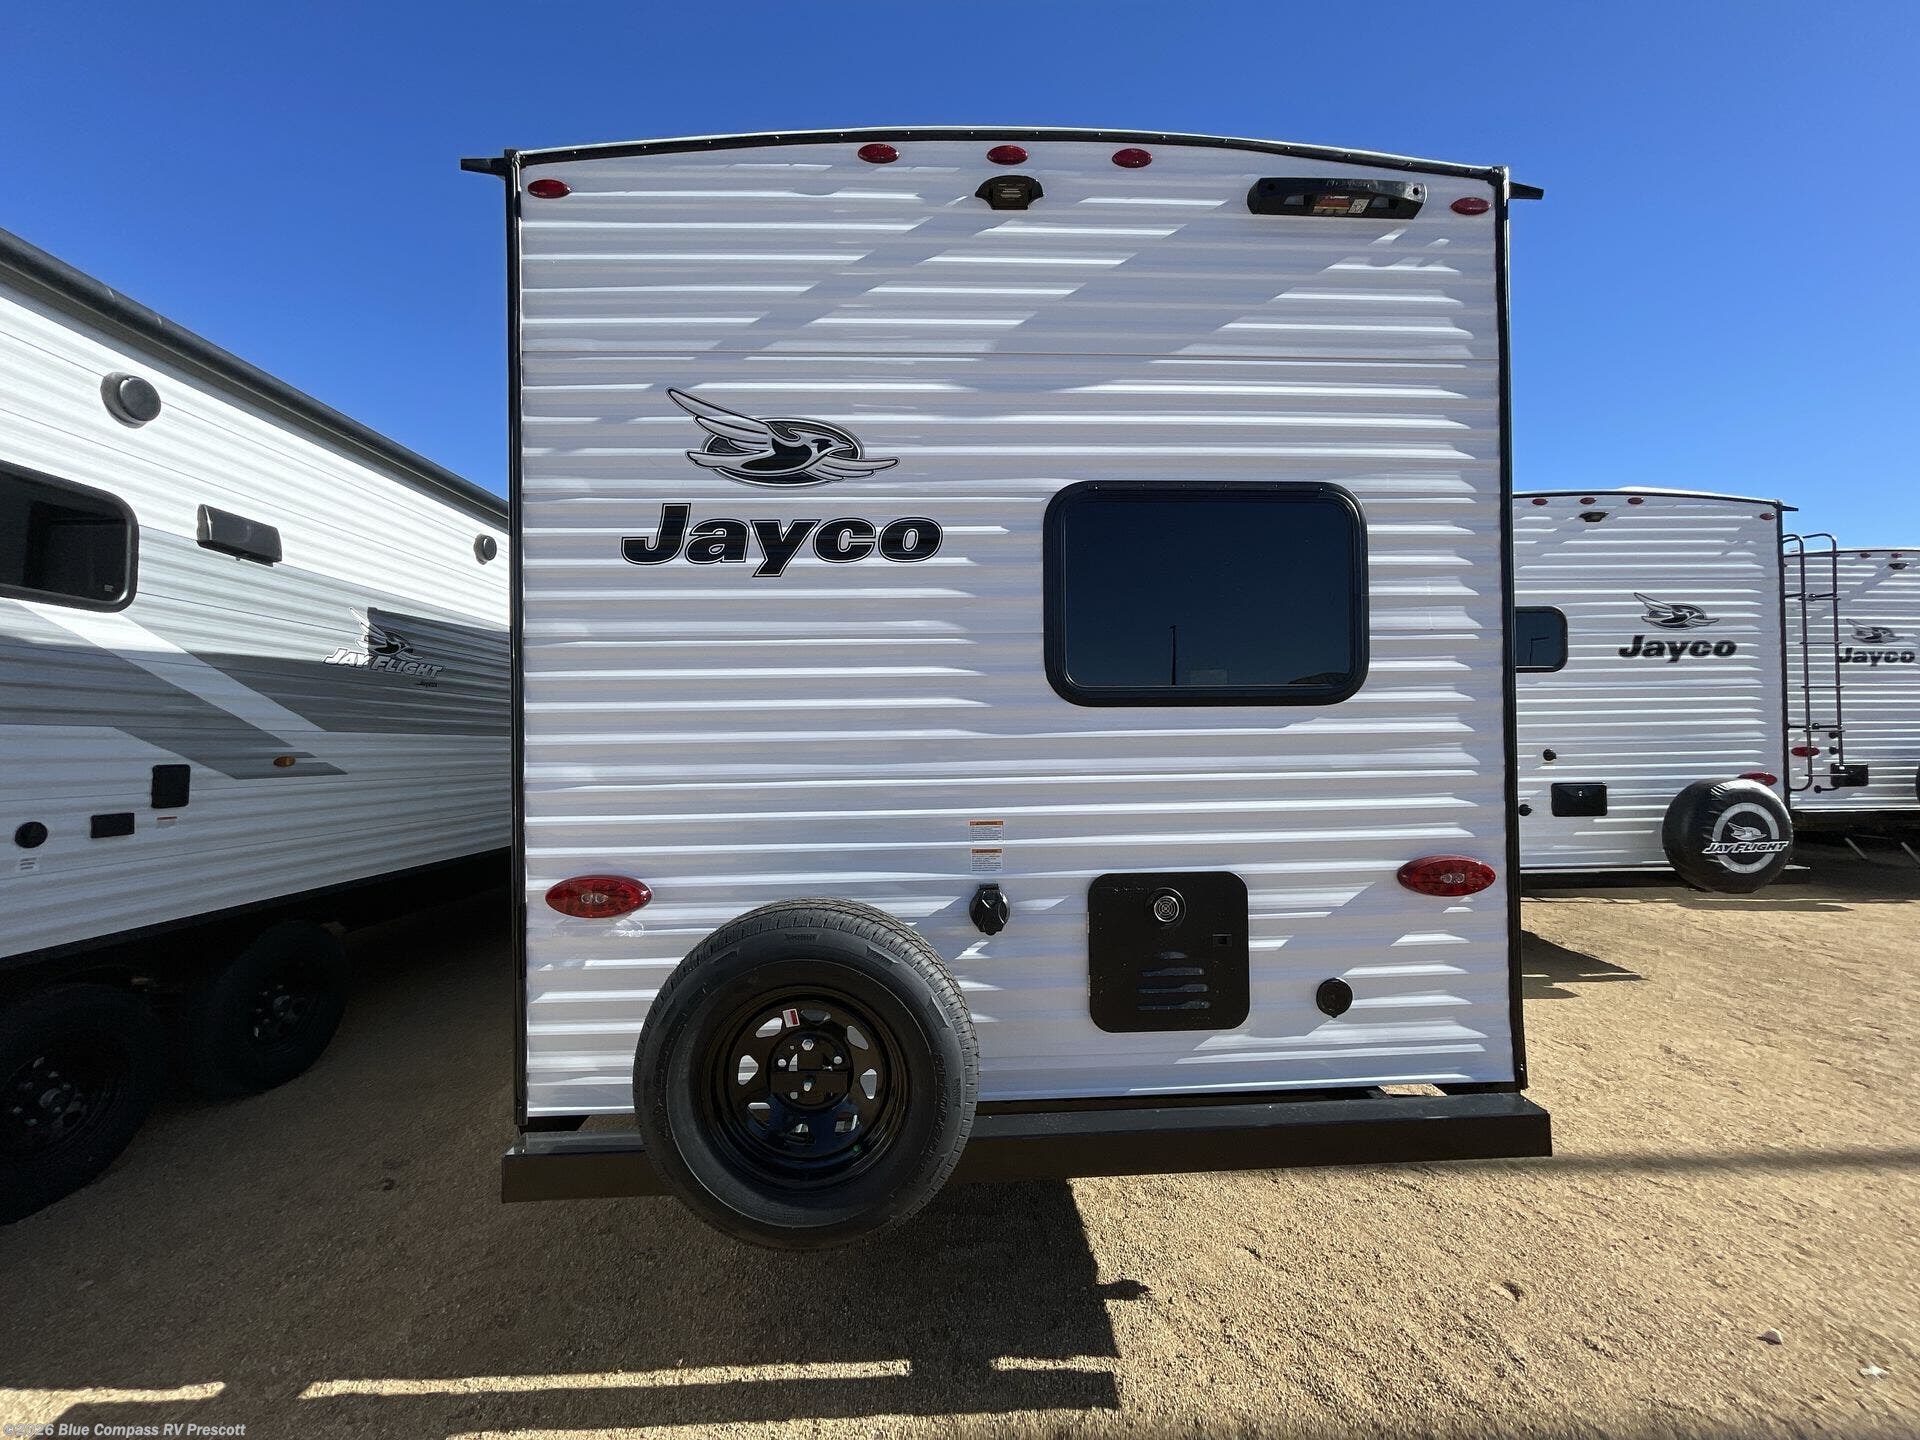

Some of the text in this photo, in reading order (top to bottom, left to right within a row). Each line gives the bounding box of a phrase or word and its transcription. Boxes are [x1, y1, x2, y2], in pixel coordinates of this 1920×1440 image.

[620, 502, 944, 577] Jayco
[322, 647, 442, 678] JAY FLIGHT
[1618, 634, 1738, 664] Jayco
[1838, 647, 1916, 667] Jayco
[1703, 841, 1788, 853] JAY FLIGHT
